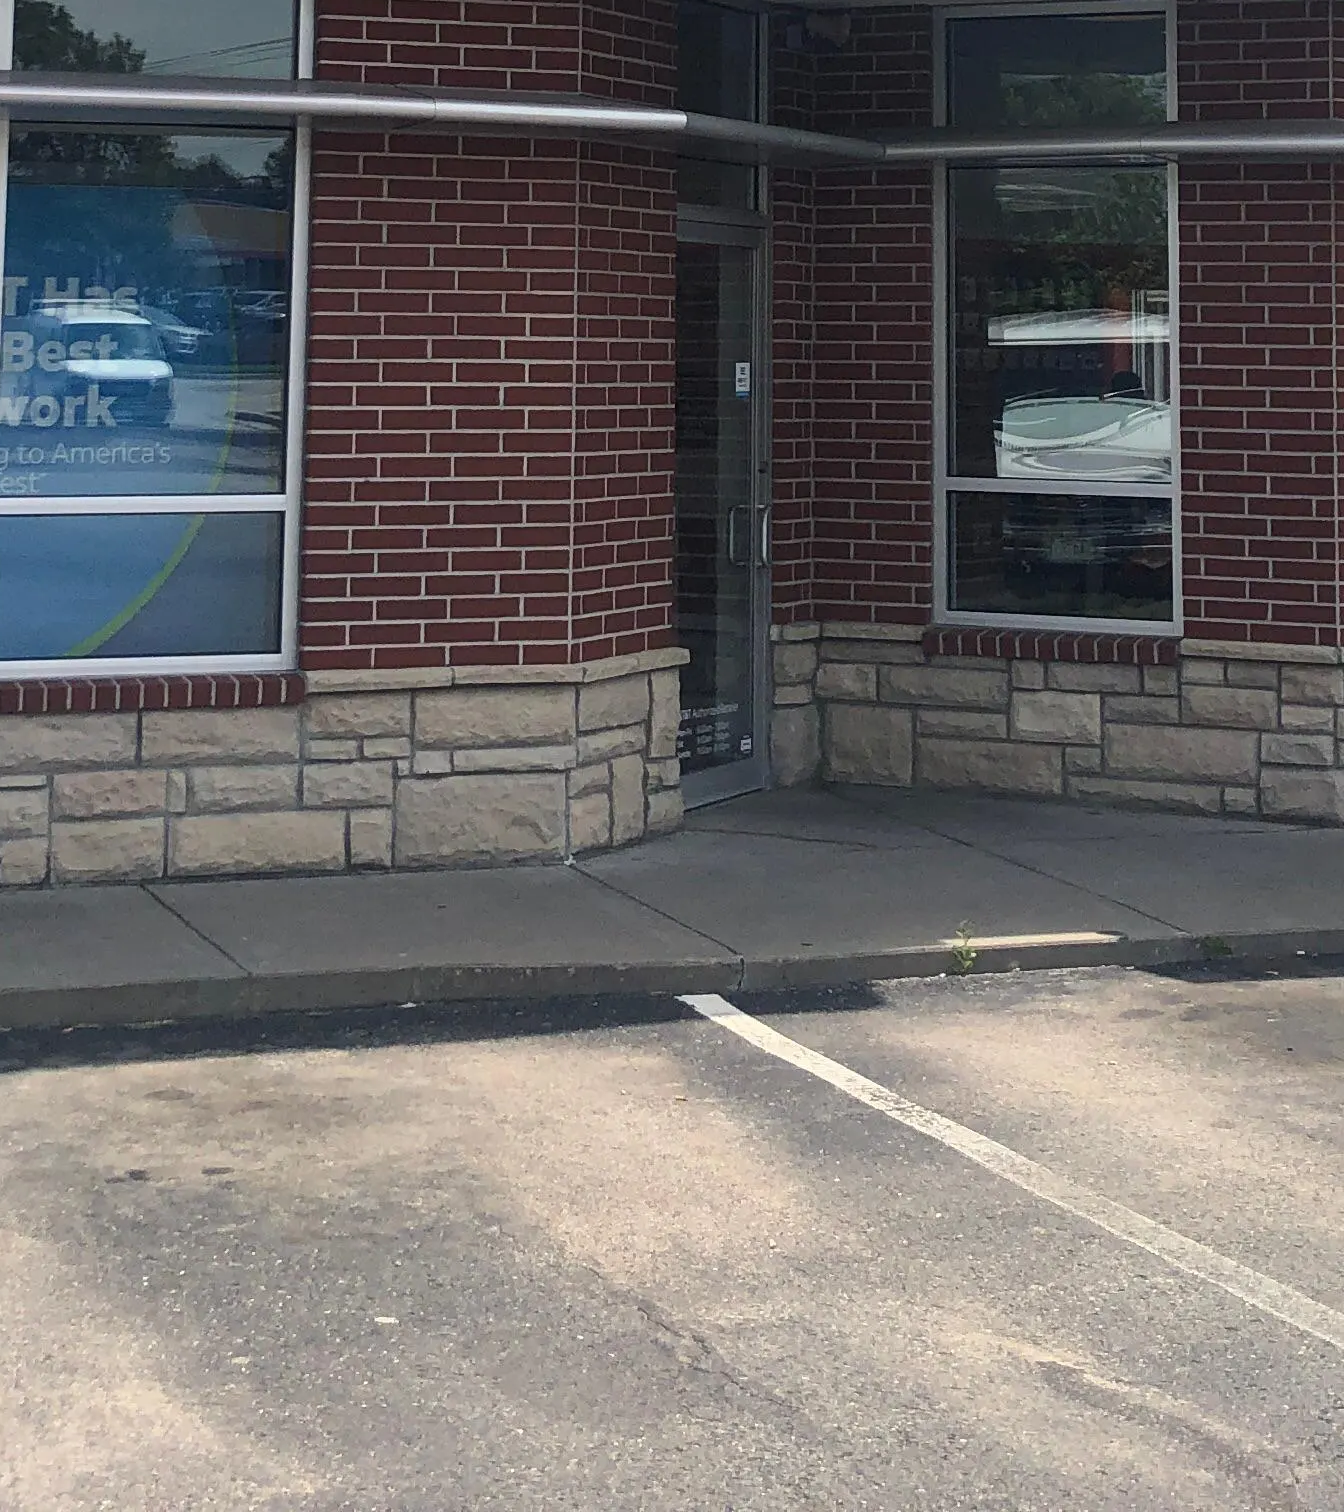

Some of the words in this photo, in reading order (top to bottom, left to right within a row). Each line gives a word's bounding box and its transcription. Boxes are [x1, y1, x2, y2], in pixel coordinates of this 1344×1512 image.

[2, 332, 119, 373] Best
[18, 445, 43, 464] to
[51, 442, 171, 465] America's
